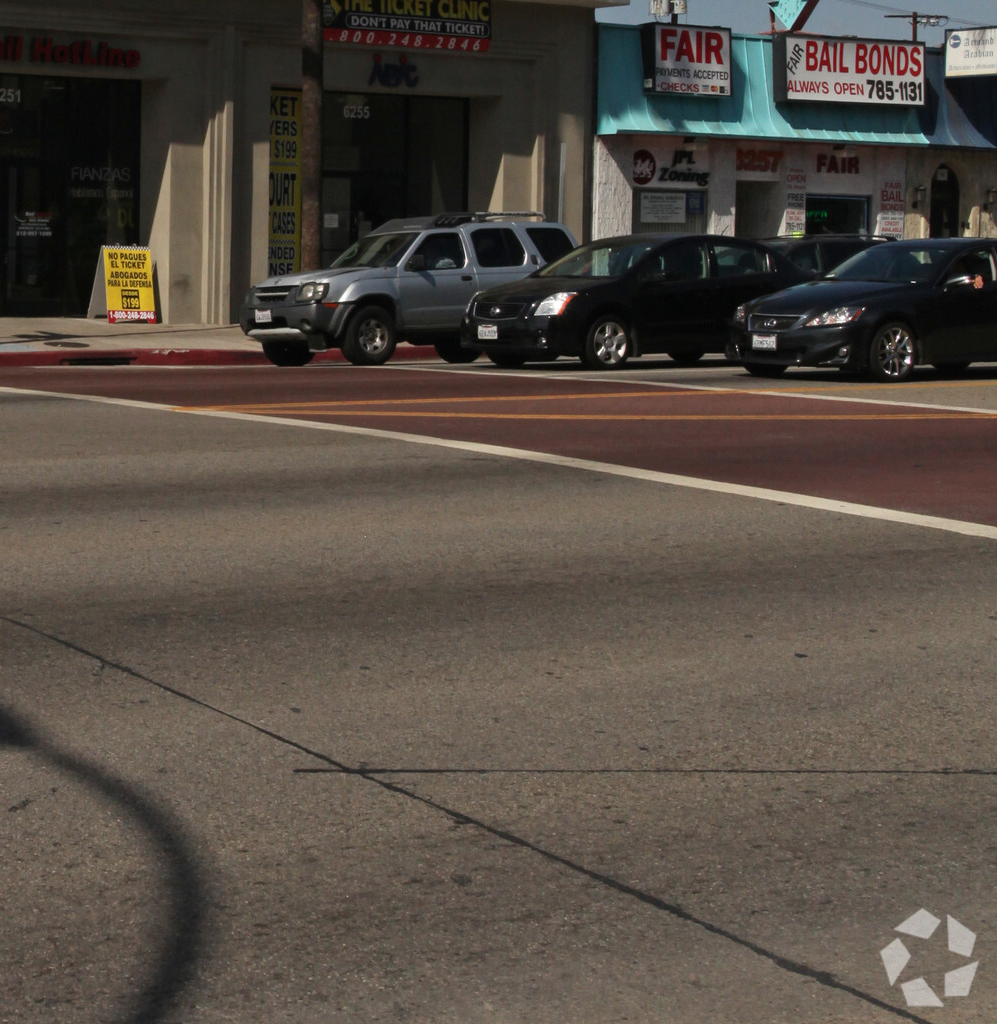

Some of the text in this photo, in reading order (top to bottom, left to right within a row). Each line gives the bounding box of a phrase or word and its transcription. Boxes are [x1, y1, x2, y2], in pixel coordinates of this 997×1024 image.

[350, 16, 485, 35] DON'T PAY THAT TICKET!
[32, 36, 140, 67] HotLine
[660, 28, 724, 64] FAIR
[786, 41, 922, 77] FAIR BAIL BONDS
[656, 68, 729, 80] PAYMENTS ACCEPTED
[788, 79, 922, 102] ALWAYS OPEN 785-1131
[343, 106, 370, 119] 6255
[672, 150, 696, 166] JPL
[816, 154, 860, 174] FAIR
[72, 167, 130, 182] FIANZAS
[658, 168, 710, 186] Zoning
[786, 174, 806, 182] OPEN
[882, 190, 904, 202] BAIL
[272, 212, 295, 234] CASES
[121, 261, 146, 269] TICKET
[110, 272, 148, 280] ABOGADOS
[130, 280, 152, 288] DEFENSA
[122, 298, 140, 308] $199
[110, 311, 154, 320] 1-800-248-2846
